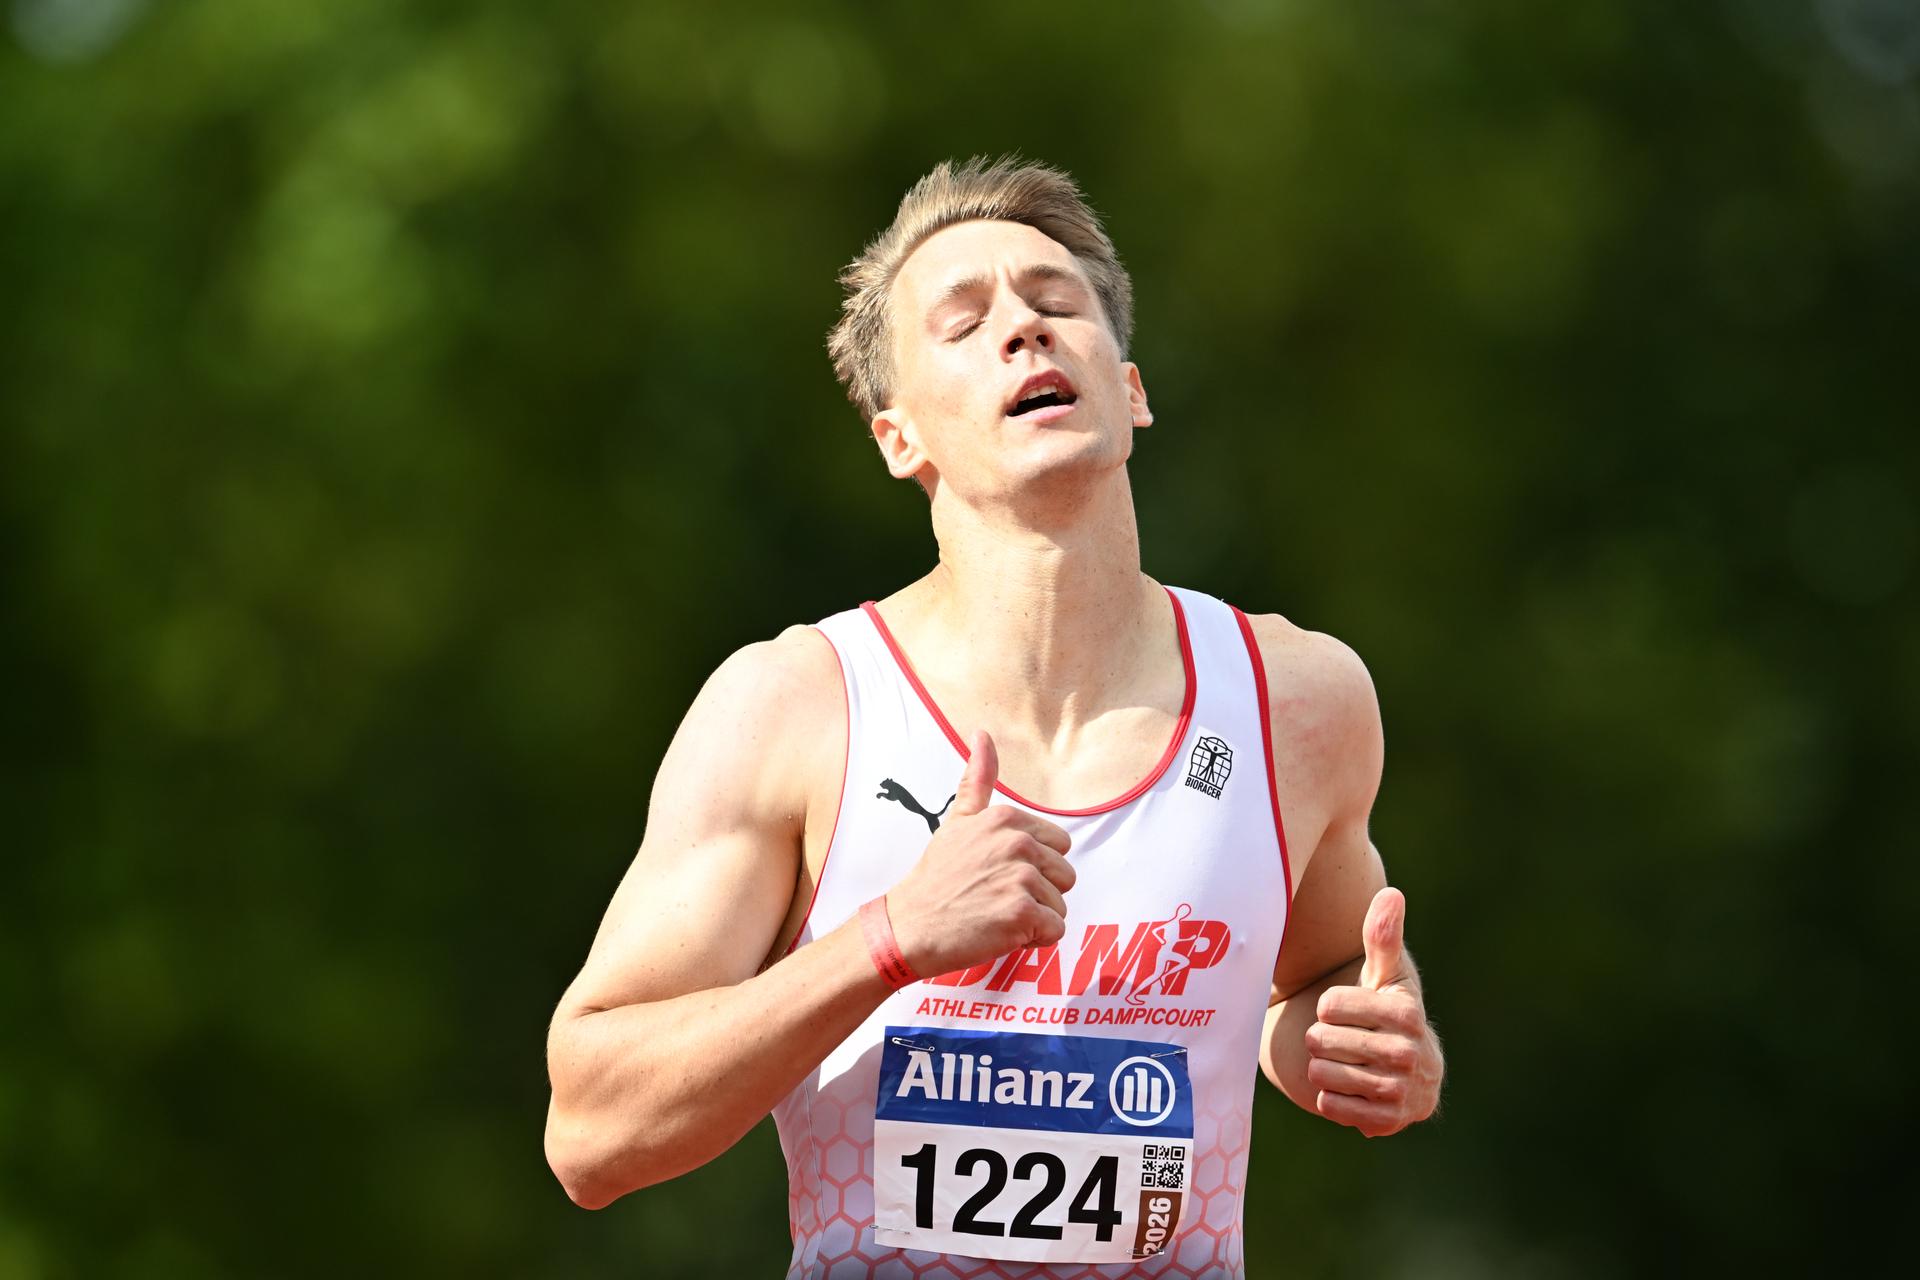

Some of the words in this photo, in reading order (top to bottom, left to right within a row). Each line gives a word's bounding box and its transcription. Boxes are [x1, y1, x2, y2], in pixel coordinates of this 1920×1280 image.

[1184, 776, 1222, 801] BIORACER
[916, 997, 1017, 1022] ATHLETIC
[1022, 1004, 1080, 1025] CLUB
[1084, 1007, 1216, 1027] DAMPICOURT
[896, 1050, 1095, 1110] Allianz
[901, 1143, 1122, 1242] 1224
[1142, 1197, 1172, 1256] 2026
